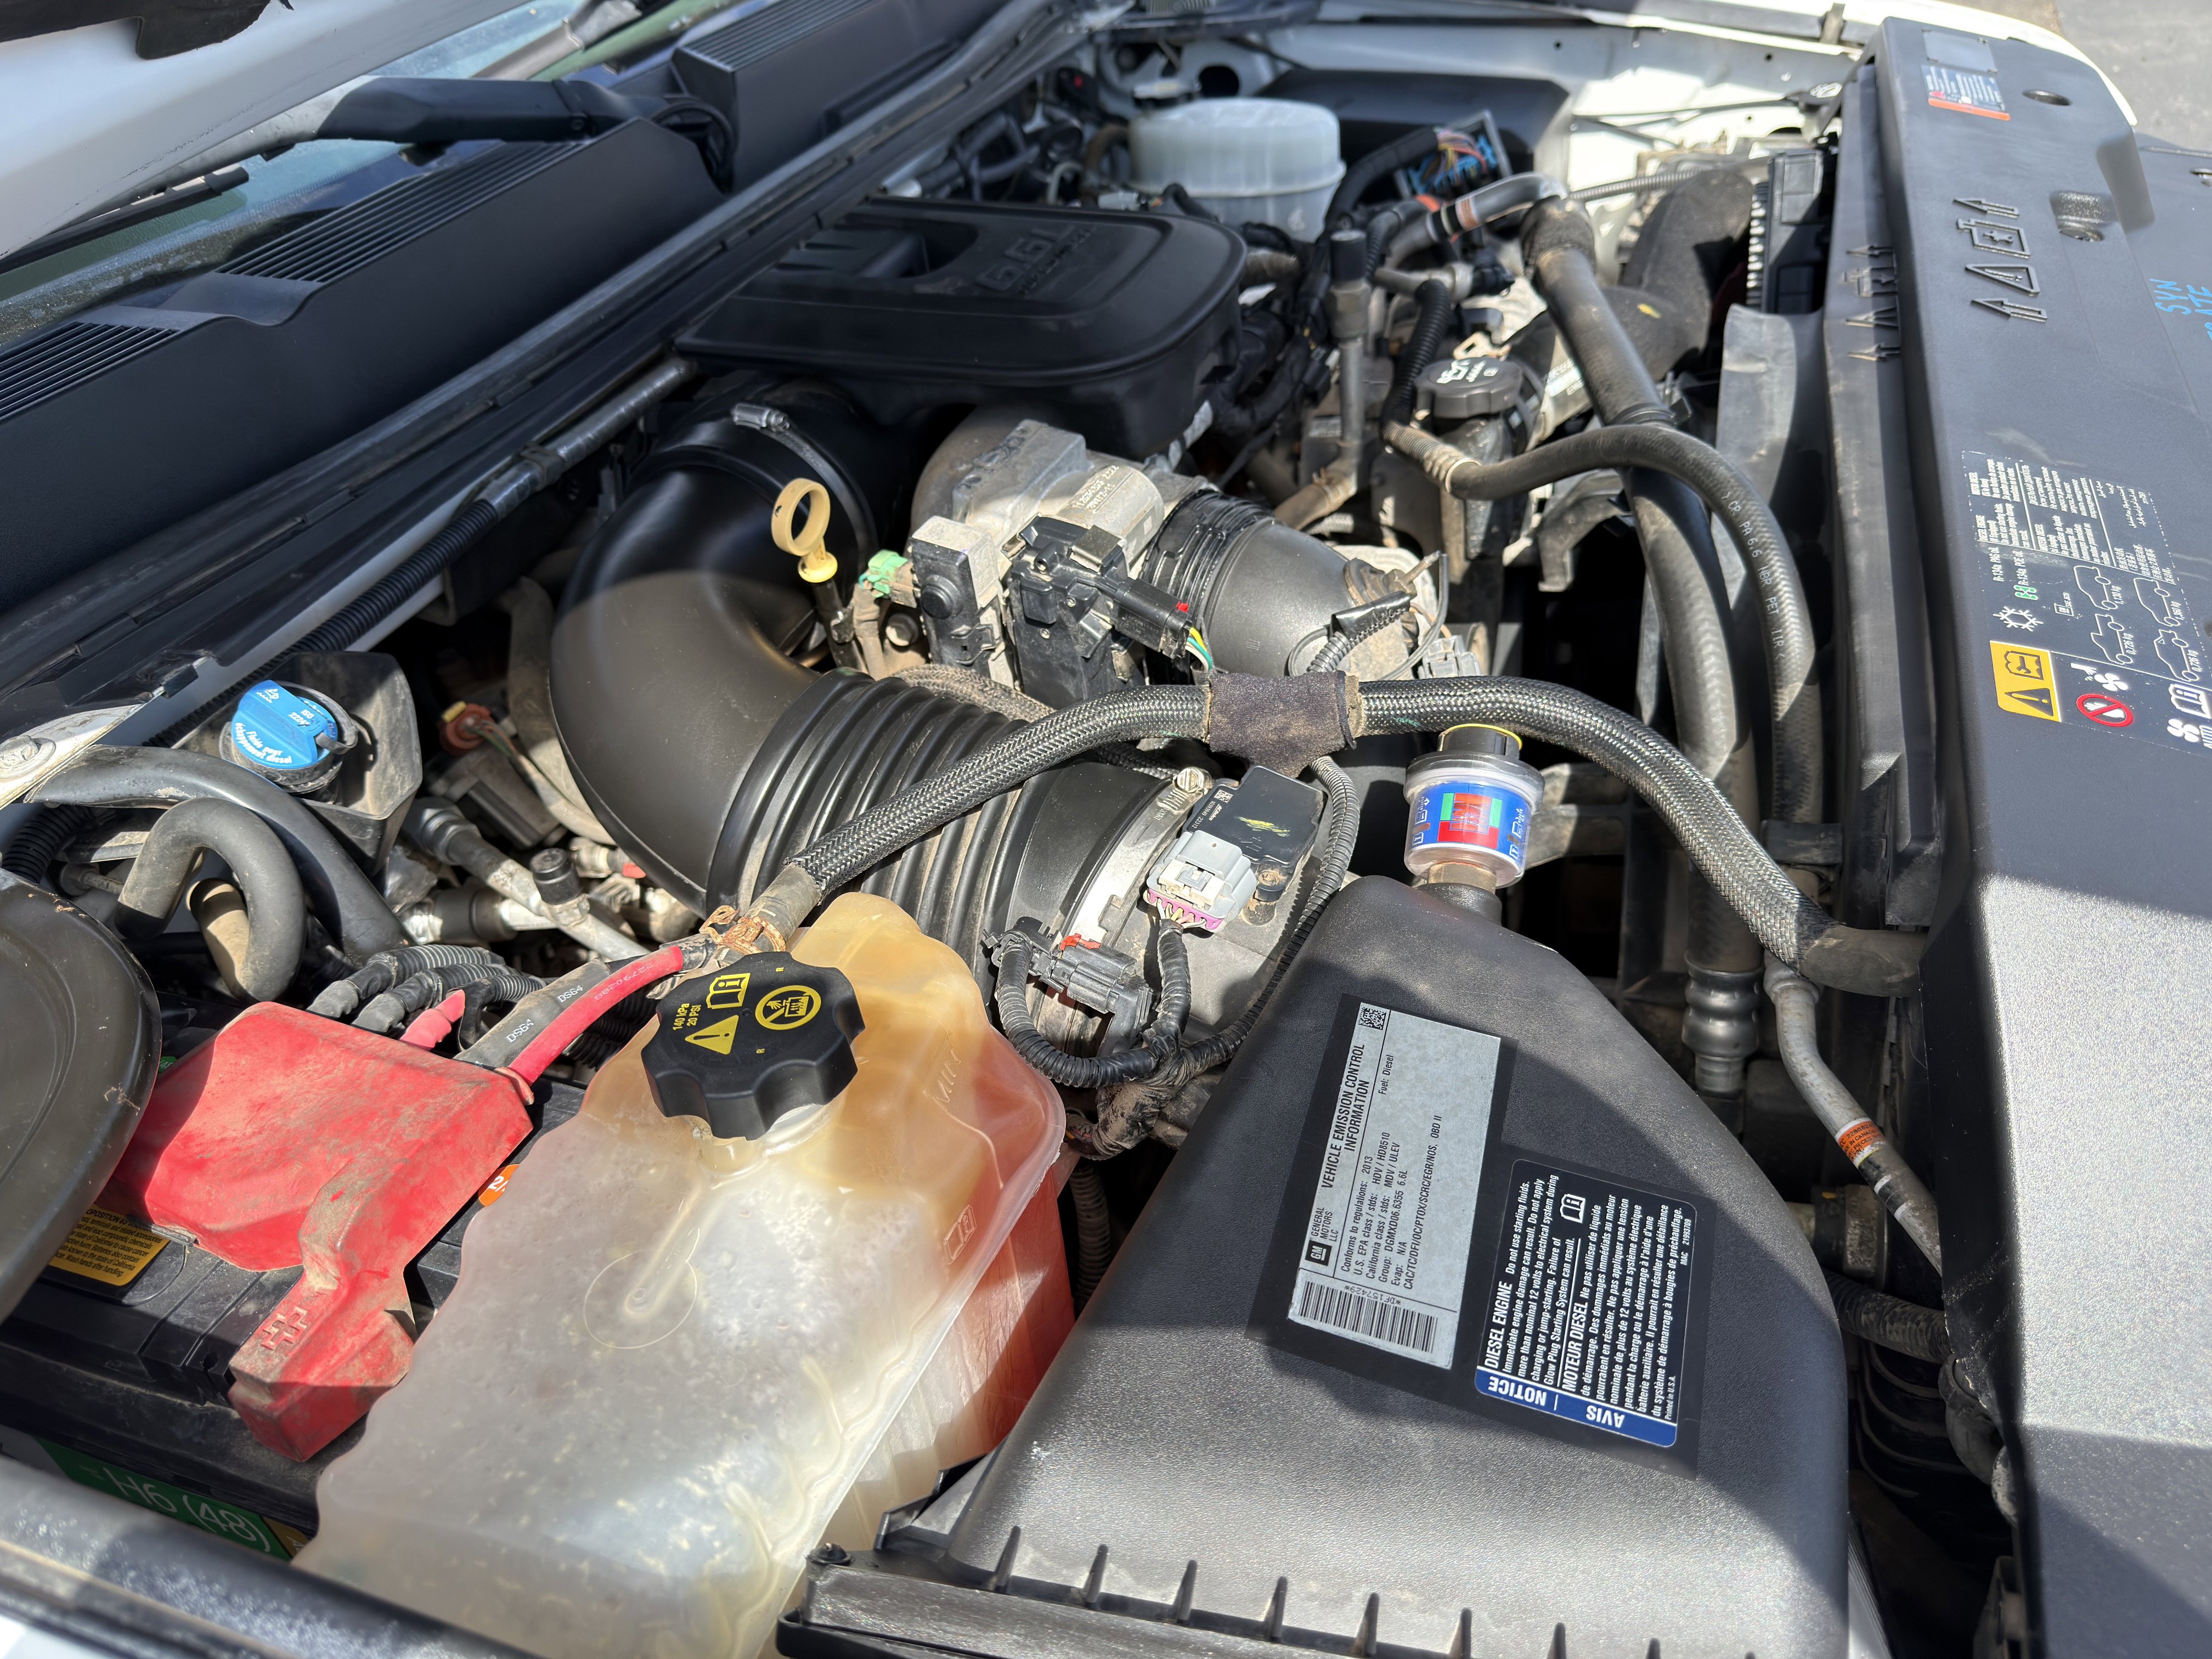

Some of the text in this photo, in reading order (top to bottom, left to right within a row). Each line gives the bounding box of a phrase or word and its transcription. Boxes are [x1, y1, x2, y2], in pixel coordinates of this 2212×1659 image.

[2149, 278, 2192, 315] SYN
[1977, 528, 1989, 541] DIESEL
[1989, 552, 2001, 563] PAG
[2013, 556, 2025, 567] POE
[1991, 564, 2005, 582] R-134a
[2016, 568, 2029, 586] R-134a
[2112, 591, 2125, 605] 1,130
[2171, 607, 2185, 620] 1,360
[2122, 633, 2137, 655] 0,726 kg
[2187, 649, 2203, 672] 0,726 kg
[300, 709, 315, 719] ISO
[246, 731, 284, 756] Fluide pour
[266, 755, 292, 764] diesel
[1192, 816, 1204, 829] 22312
[1209, 804, 1222, 821] ACDelco
[672, 1003, 690, 1031] 140 kPa
[686, 1005, 702, 1026] 20 PSI
[1378, 1054, 1393, 1094] Fuel: Diesel
[1321, 1045, 1364, 1188] VEHICLE EMISSION CONTROL
[1344, 1080, 1369, 1151] INFORMATION
[1376, 1132, 1390, 1160] HD8510
[1389, 1142, 1400, 1162] ULEV
[1372, 1167, 1383, 1184] HDV
[1384, 1169, 1395, 1187] MDV
[1341, 1235, 1356, 1272] Conforms
[1353, 1181, 1367, 1223] regulations:
[1361, 1156, 1373, 1174] 2013
[1367, 1193, 1378, 1211] stds:
[1379, 1195, 1390, 1213] stds:
[1403, 1144, 1438, 1289] CAC/TC/DFI/OC/PTOX/SCRC/EGR/NOS,
[1430, 1122, 1440, 1138] OBD
[1311, 1207, 1324, 1236] GENERAL
[1319, 1211, 1333, 1239] MOTORS
[1362, 1218, 1373, 1237] class
[1374, 1220, 1385, 1239] class
[1378, 1170, 1407, 1282] Group: DGMXD06.6355 6.6L
[1328, 1229, 1338, 1242] LLC
[1357, 1240, 1368, 1255] EPA
[1680, 1218, 1691, 1265] MAC 21993709
[1353, 1260, 1364, 1275] U.S.
[1365, 1242, 1381, 1279] California
[1391, 1242, 1407, 1286] Evap: N/A
[1484, 1181, 1529, 1368] DIESEL ENGINE Do not use starting fluids.
[1502, 1178, 1544, 1373] Immediate engine damage can result. Do not apply
[1517, 1175, 1559, 1377] more than nominal 12 volts to electrical system during
[1562, 1205, 1601, 1391] MOTEUR DIESEL Ne pas utiliser de liquide
[1581, 1194, 1616, 1396] de démarrage. Des dommages immédiats au moteur
[1530, 1237, 1560, 1381] charging or jump-starting. Failure of
[1544, 1238, 1575, 1385] Glow Plug Starting System can result.
[1487, 1375, 1548, 1406] NOTICE
[1585, 1404, 1625, 1429] AVIS
[102, 1466, 270, 1553] H6 (48)
